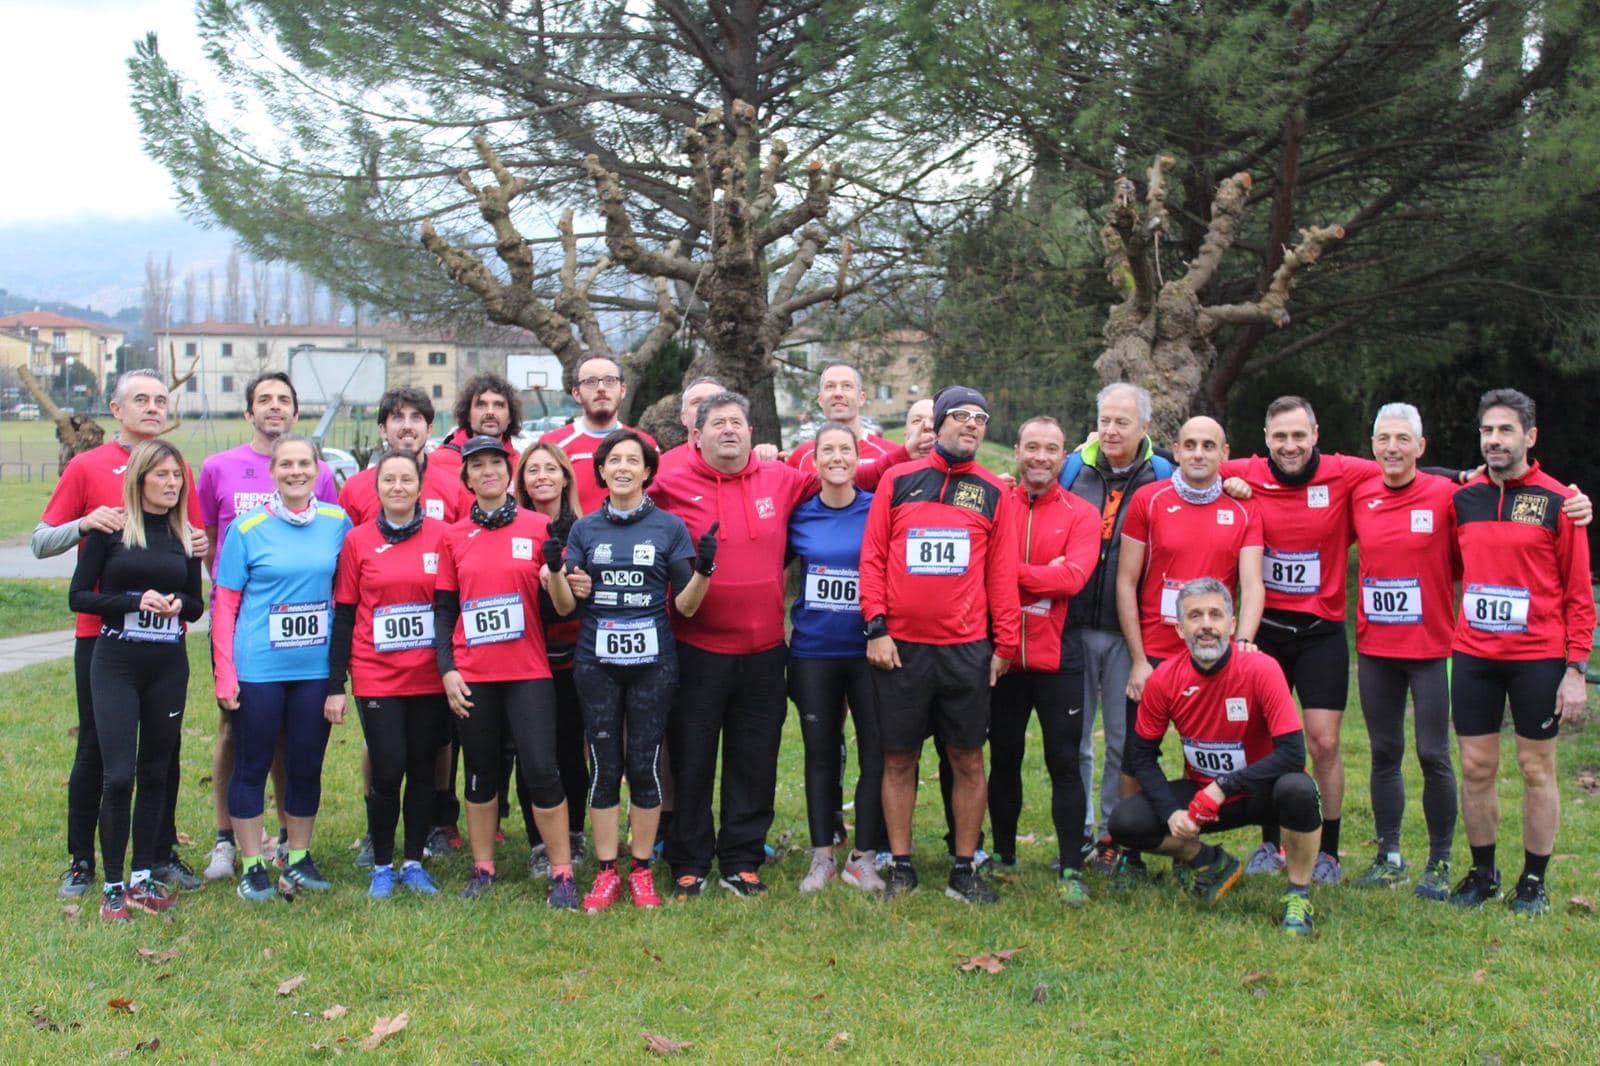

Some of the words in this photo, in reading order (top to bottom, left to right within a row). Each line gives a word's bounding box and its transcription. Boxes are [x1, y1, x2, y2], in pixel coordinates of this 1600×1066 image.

[920, 542, 955, 563] 814
[602, 571, 643, 585] A&O
[1273, 562, 1306, 583] 812
[817, 579, 856, 601] 906
[1373, 591, 1408, 612] 802
[1476, 598, 1512, 621] 819
[282, 615, 318, 637] 908
[385, 616, 423, 639] 905
[476, 608, 510, 632] 651
[607, 632, 646, 654] 653
[1195, 751, 1234, 771] 803
